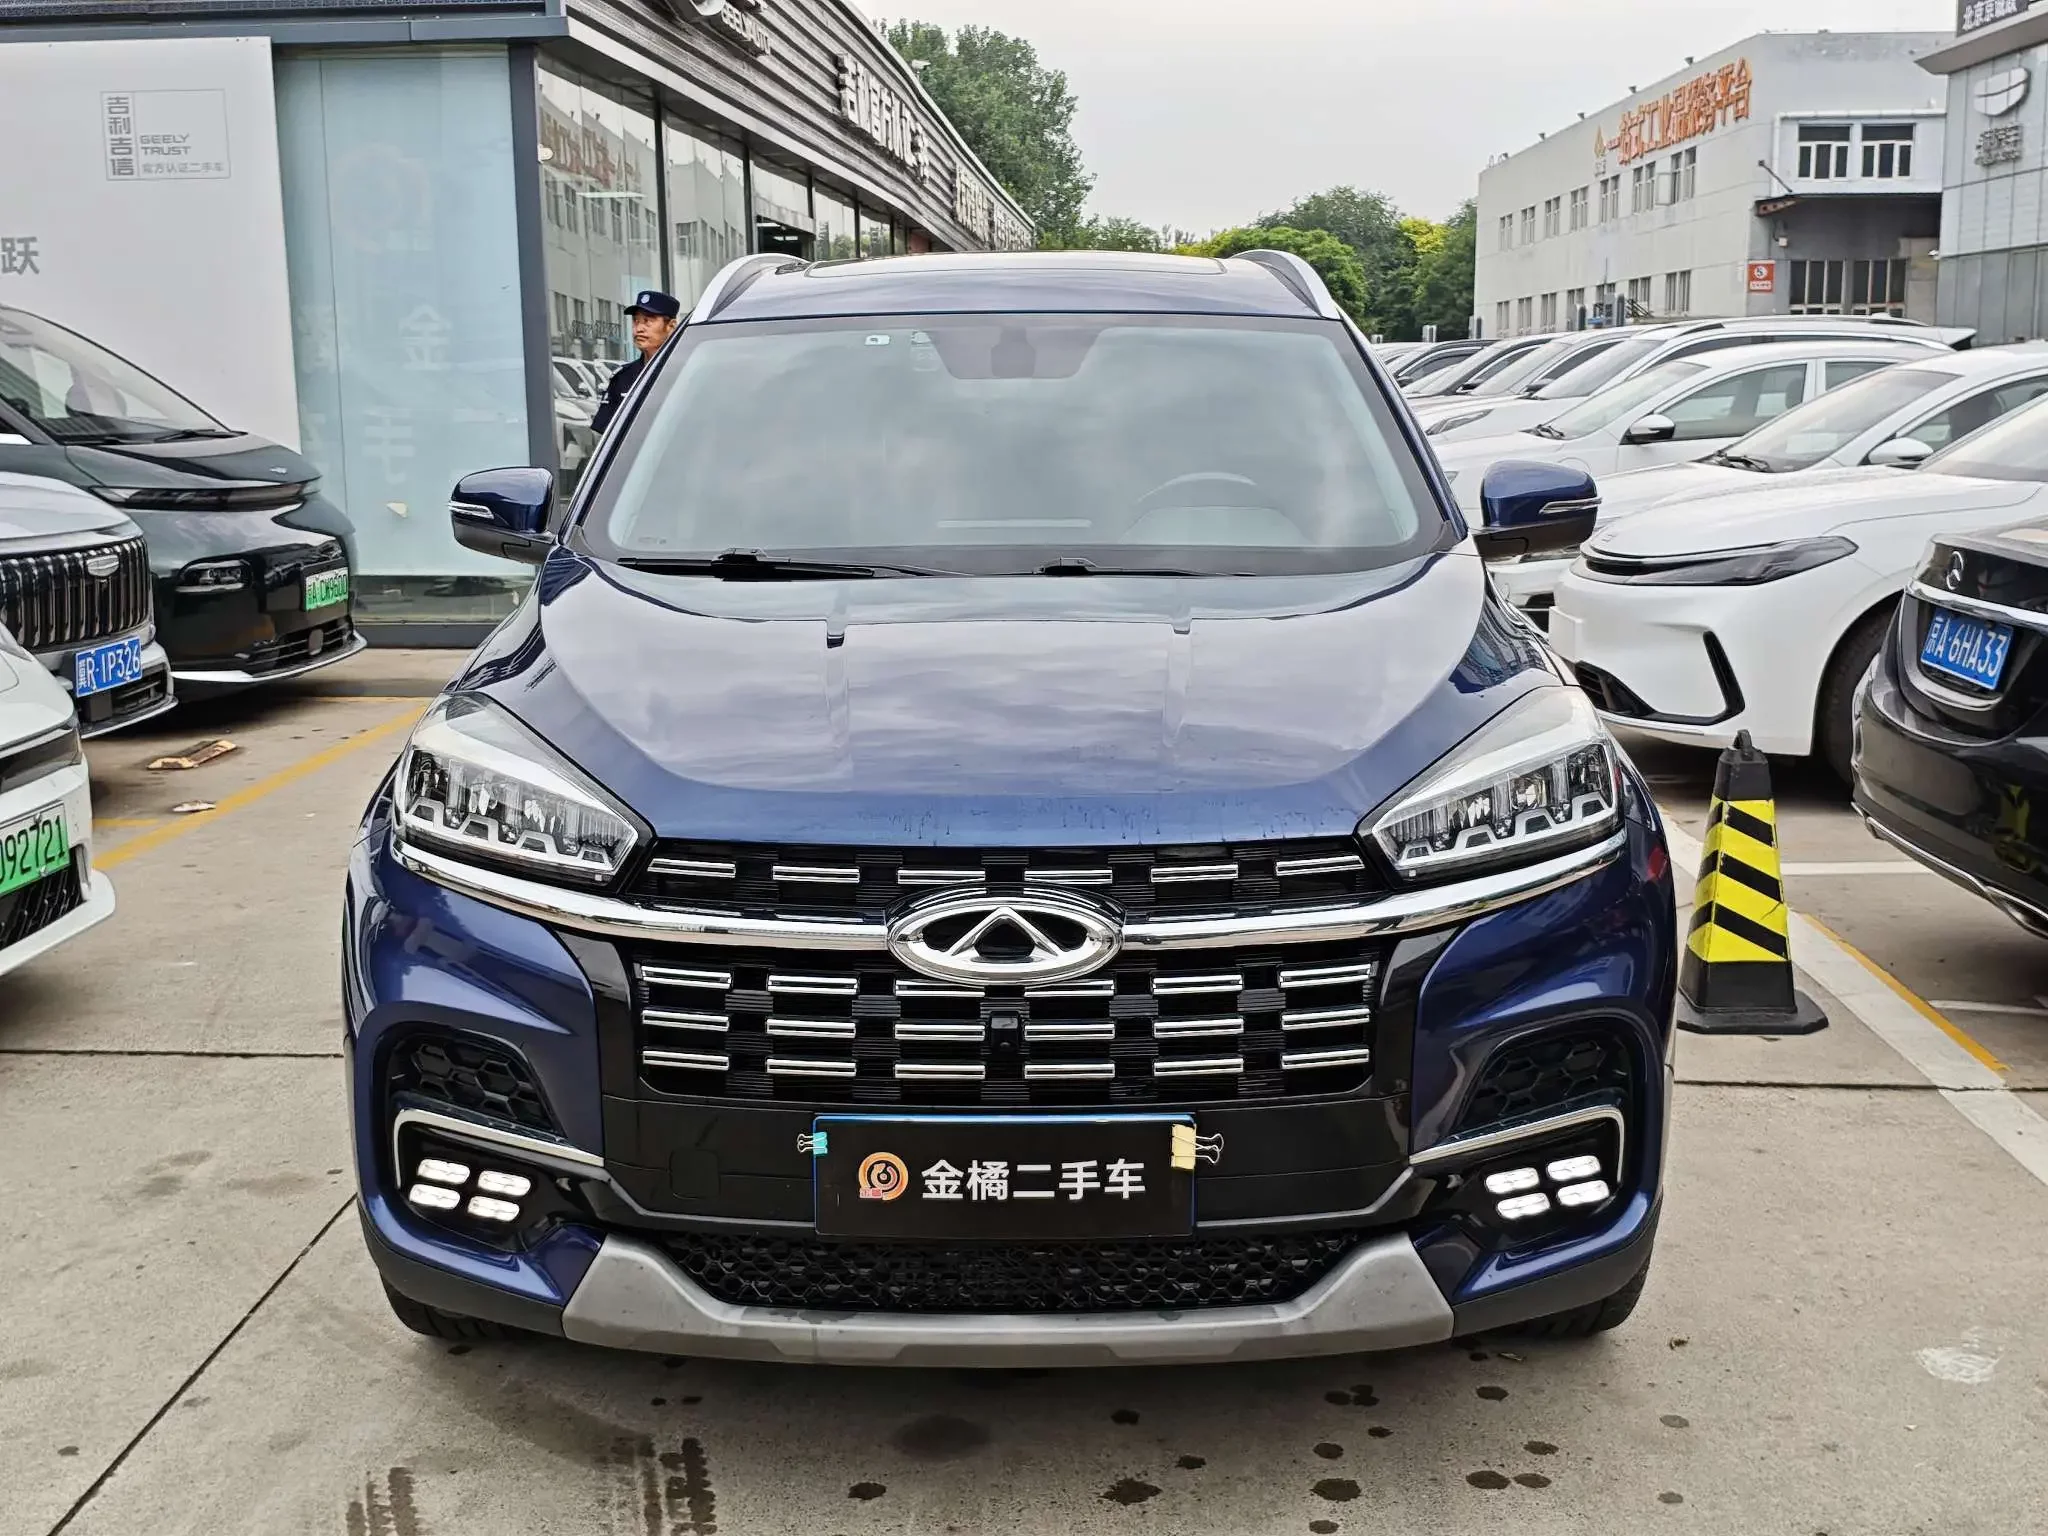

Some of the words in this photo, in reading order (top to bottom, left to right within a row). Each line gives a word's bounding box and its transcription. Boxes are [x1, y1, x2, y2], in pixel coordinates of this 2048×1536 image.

[107, 96, 134, 176] 吉利吉信
[140, 133, 190, 144] GEELY
[140, 146, 191, 156] TRUST
[921, 1159, 1146, 1201] 金橘二手车
